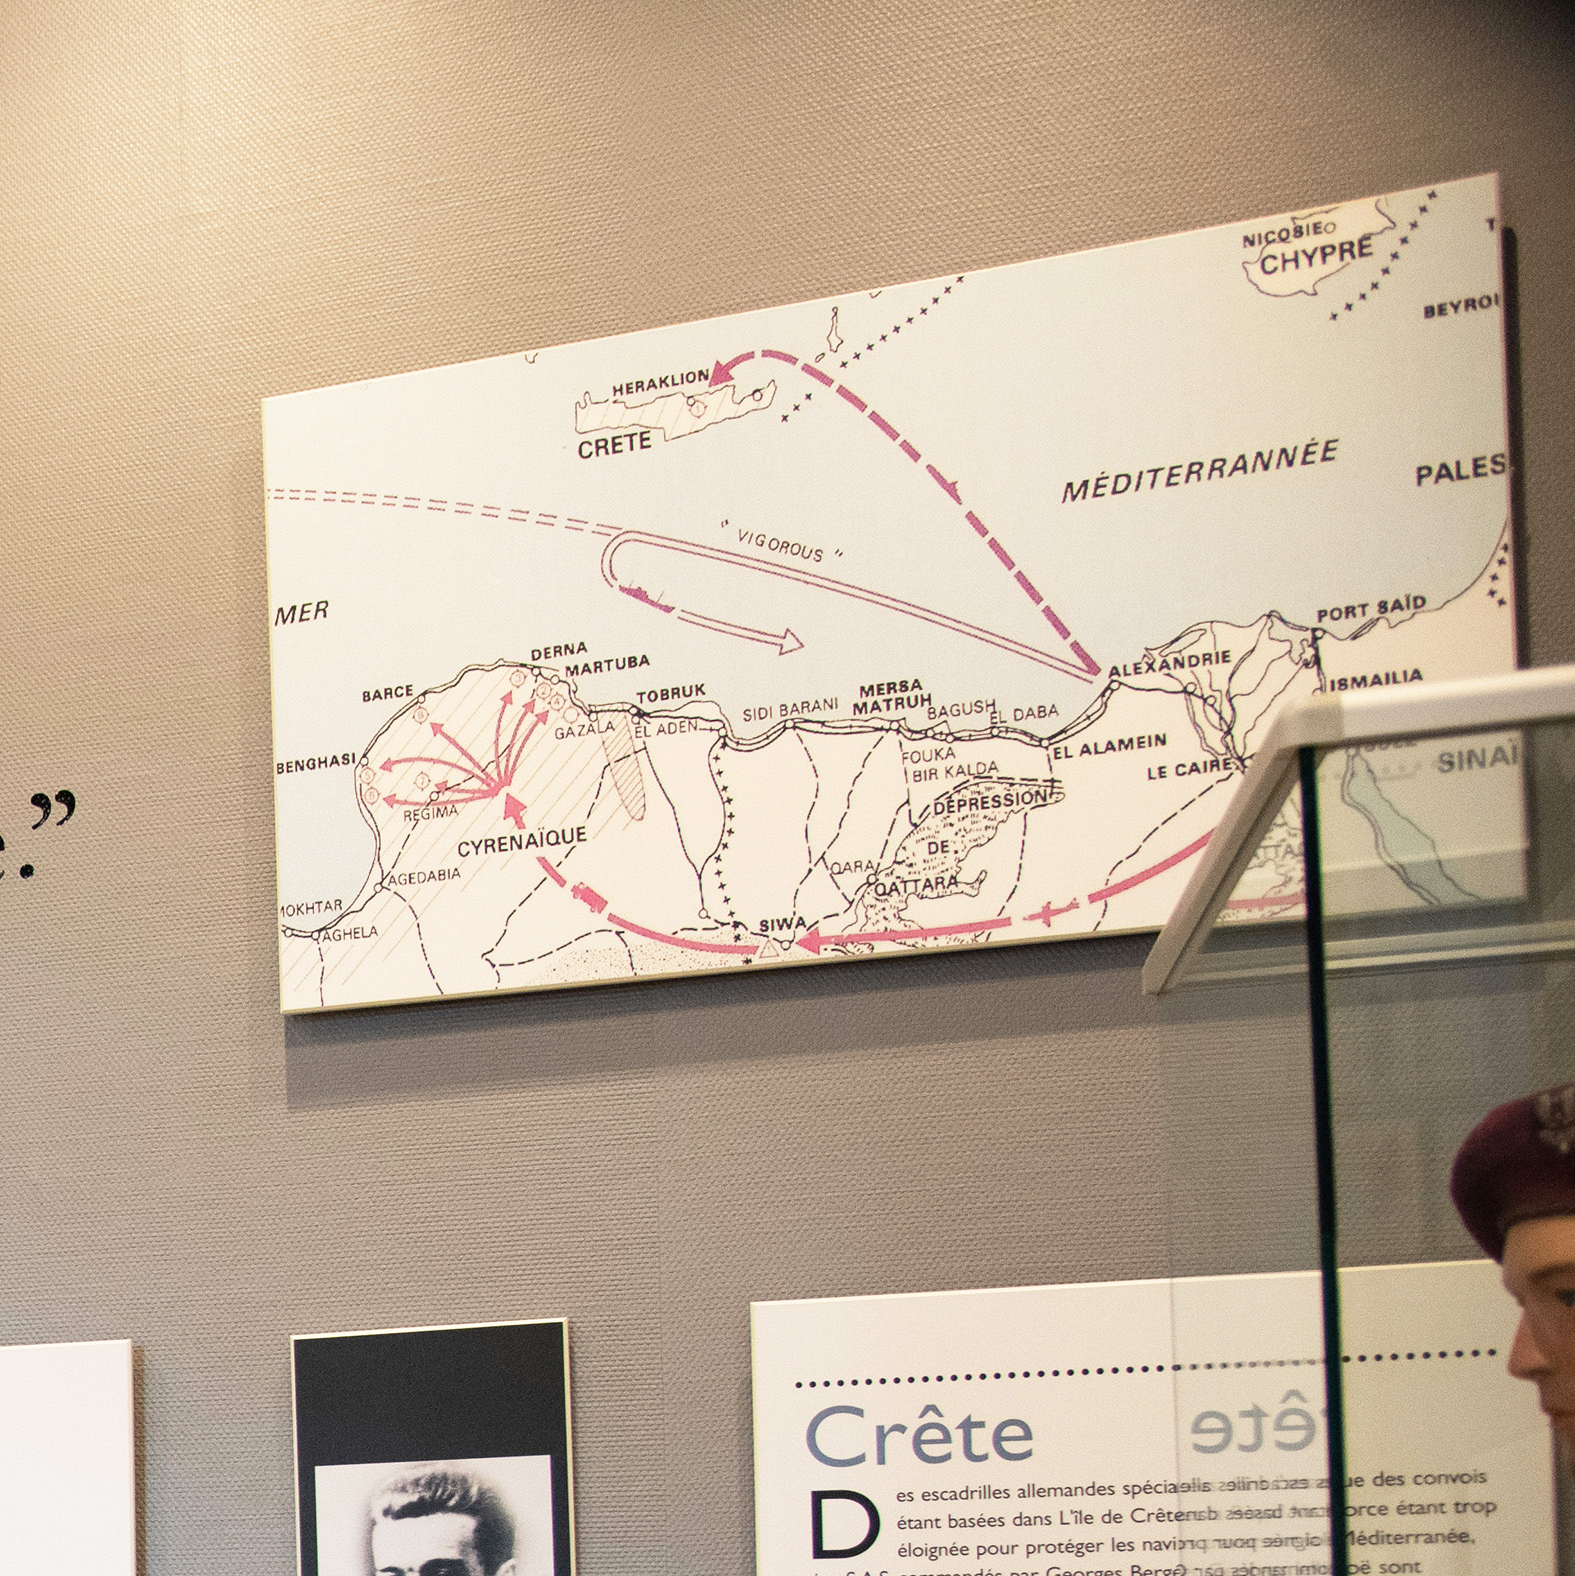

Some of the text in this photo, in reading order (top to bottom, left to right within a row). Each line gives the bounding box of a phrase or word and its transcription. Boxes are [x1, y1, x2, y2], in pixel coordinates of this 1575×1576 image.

[1243, 221, 1324, 248] NICOSIE
[1260, 235, 1373, 276] CHYPRE
[613, 369, 710, 397] HERAKLION
[577, 431, 652, 460] CRETE
[1062, 439, 1340, 504] MÉDITERRANNÉE
[275, 600, 329, 628] MER
[1317, 594, 1427, 623] PORT SAÏD
[531, 641, 588, 662] DERNA
[565, 654, 651, 679] MARTUBA
[1108, 648, 1232, 680] ALEXANDRIE
[860, 679, 922, 698] MERSA
[1330, 667, 1424, 692] ISMAILIA
[362, 684, 414, 703] BARCE
[636, 683, 705, 704] TOBRUK
[853, 693, 931, 716] MATRUH
[743, 698, 838, 722] SIDI BARANI
[927, 699, 996, 720] BAGUSH
[990, 704, 1059, 725] EL DABA
[554, 721, 616, 740] GAZALA
[902, 747, 956, 765] FOUKA
[1053, 734, 1167, 761] EL ALAMEIN
[276, 753, 356, 775] BENGHASI
[913, 761, 999, 782] BIR KALDA
[1147, 756, 1232, 782] LE CAIRE
[403, 805, 459, 822] REGIMA
[934, 789, 1047, 815] DEPRESSION
[457, 826, 588, 858] CYRENAÏQUE
[928, 840, 949, 855] DE
[388, 867, 462, 887] AGEDABIA
[322, 925, 378, 941] AGHELA
[759, 917, 807, 933] SIWA
[807, 1404, 1033, 1467] Crête
[920, 1480, 1117, 1503] escadrilles allemandes
[896, 1508, 1124, 1531] étant basées dans L'île de
[896, 1537, 1136, 1563] éloignée pour protéger les
